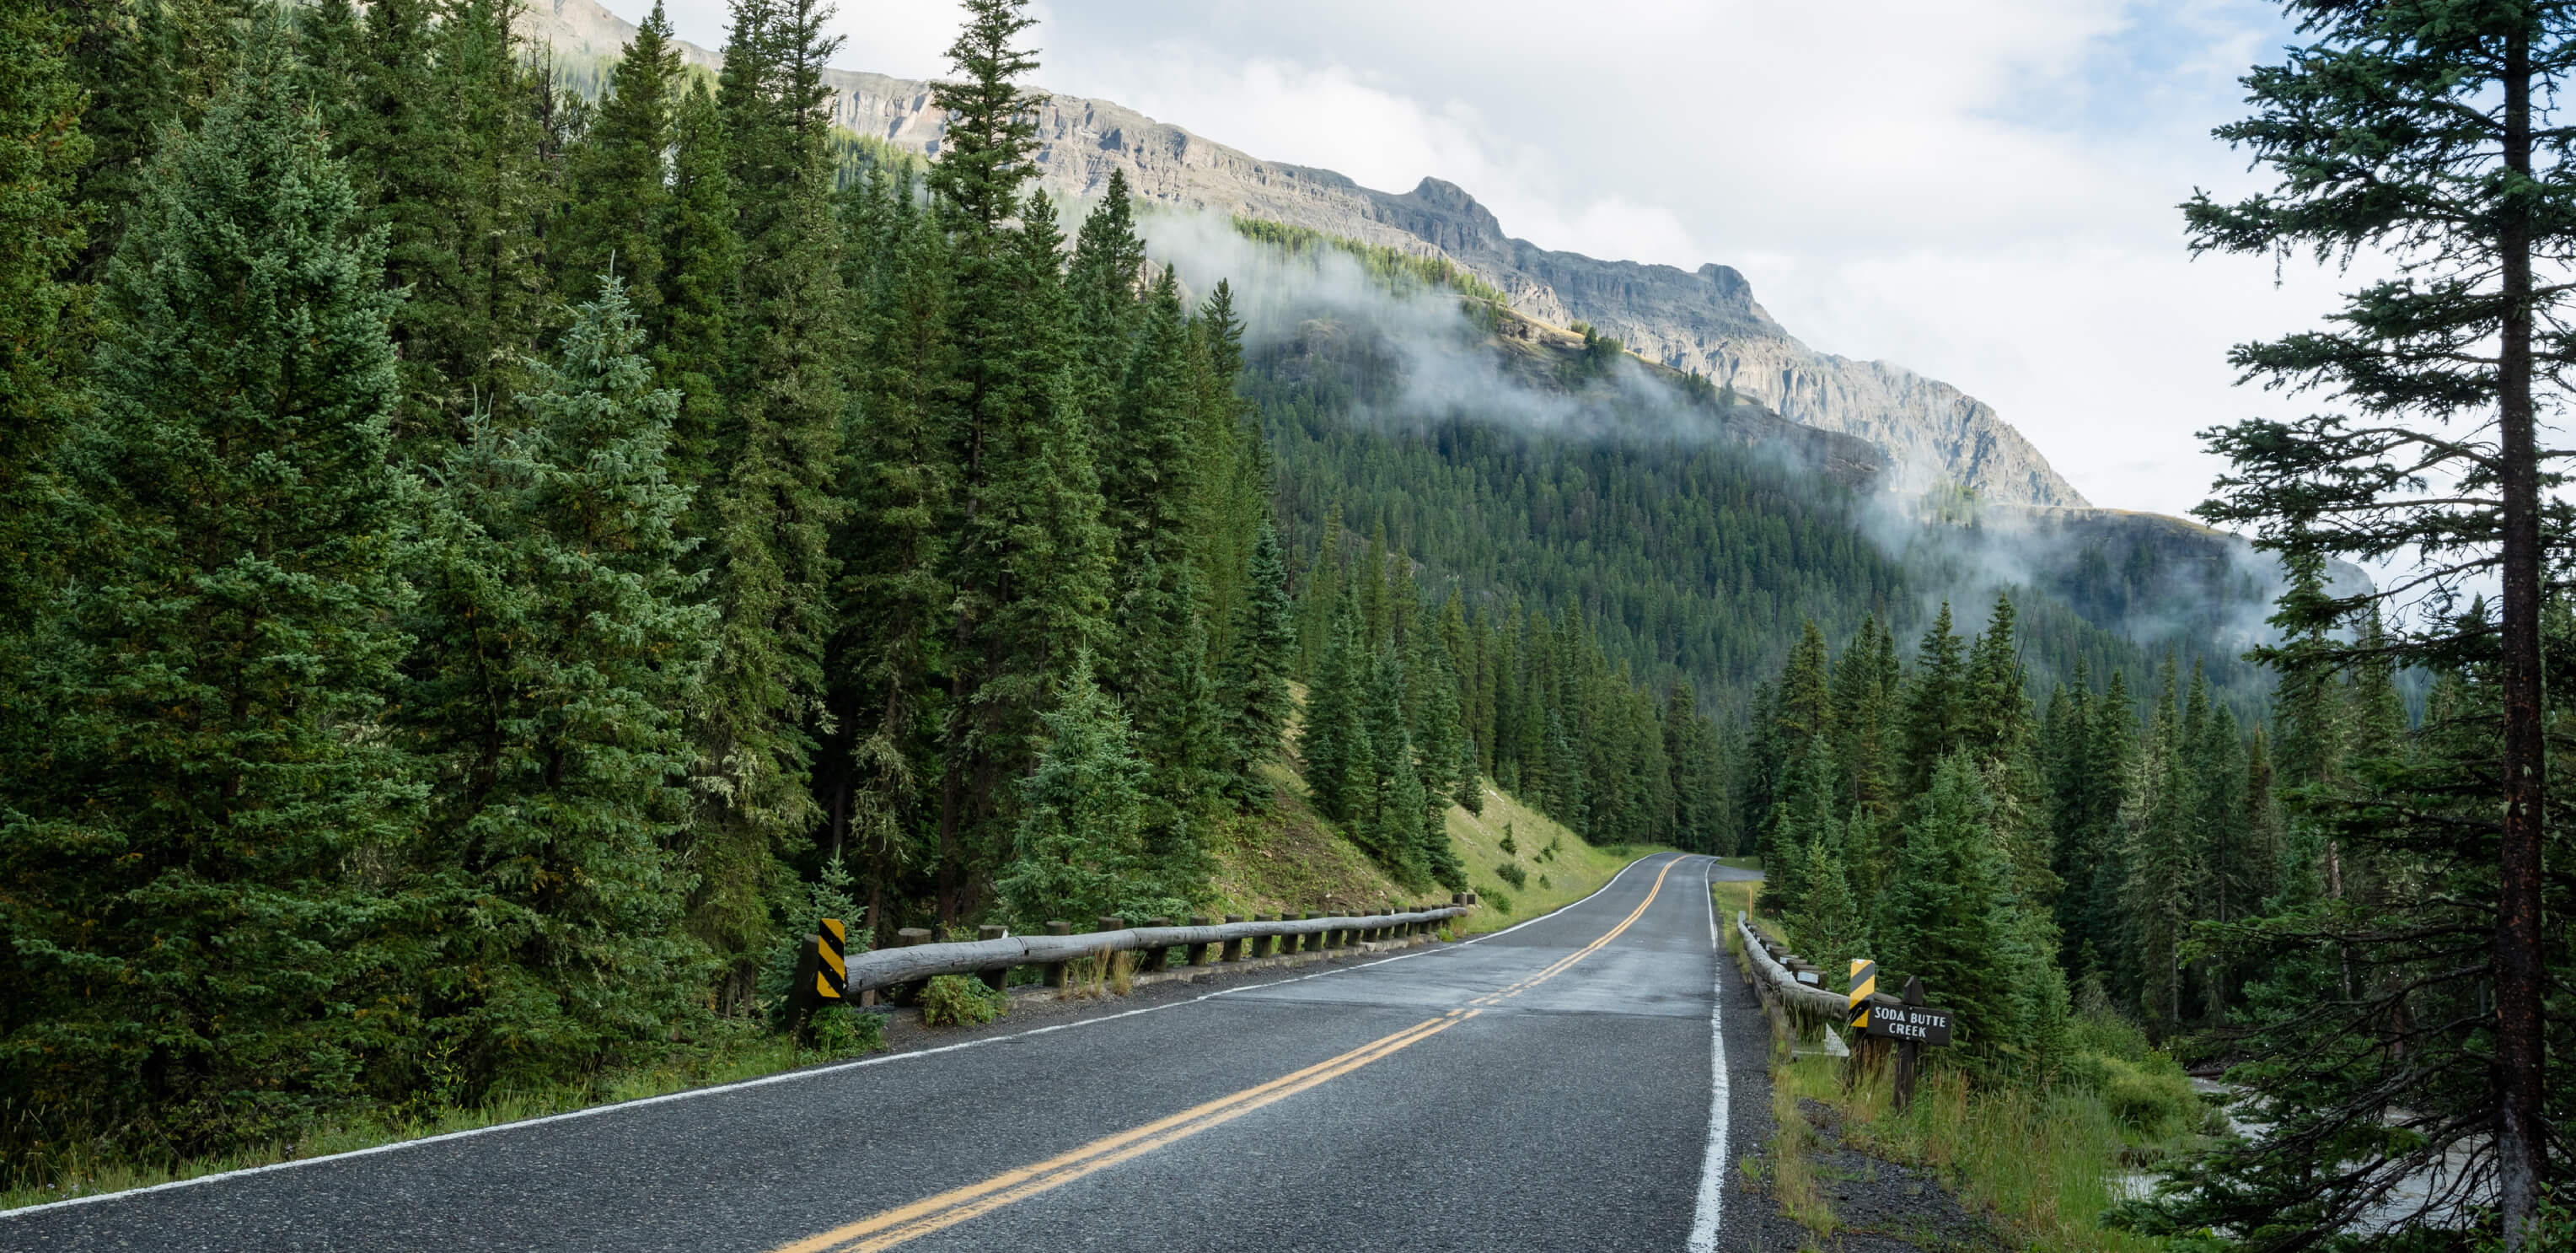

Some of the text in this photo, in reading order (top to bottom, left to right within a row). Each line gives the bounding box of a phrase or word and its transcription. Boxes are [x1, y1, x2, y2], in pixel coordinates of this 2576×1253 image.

[1875, 1006, 1946, 1028] SODA BUTTE
[1889, 1023, 1926, 1038] CREEK
